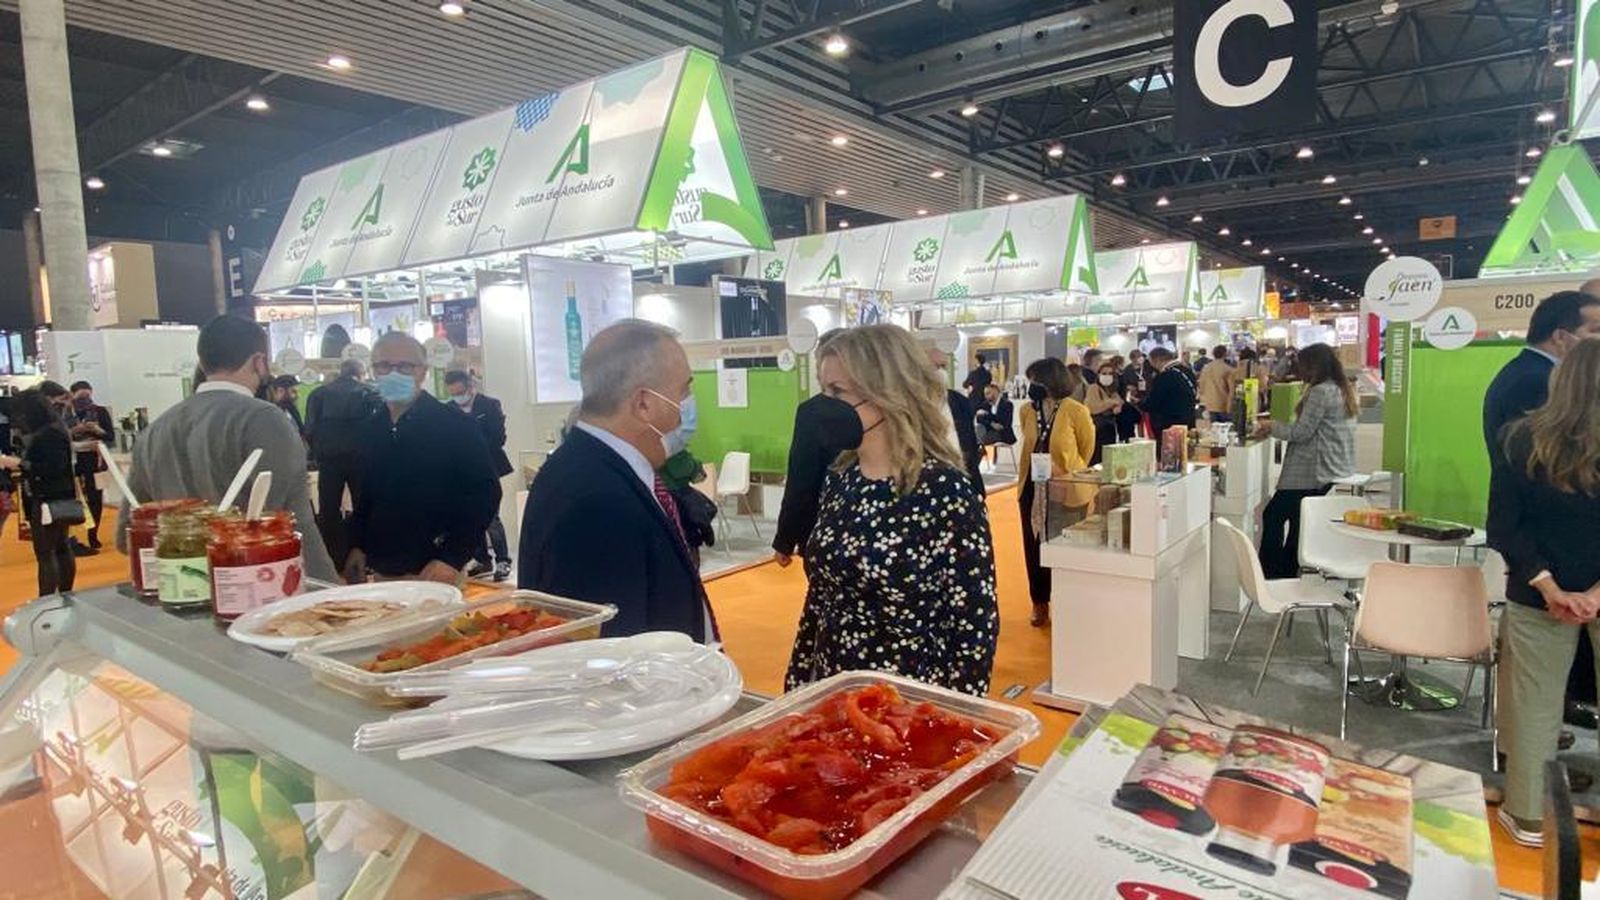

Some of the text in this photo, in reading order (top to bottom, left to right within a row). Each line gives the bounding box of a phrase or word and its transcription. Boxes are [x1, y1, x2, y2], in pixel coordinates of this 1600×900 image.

[1194, 0, 1295, 107] C
[515, 174, 616, 209] Junta de Andalucía
[229, 257, 244, 297] E
[1495, 294, 1534, 309] C200
[1393, 328, 1404, 355] FAMILY
[1096, 833, 1236, 890] Andalucía
